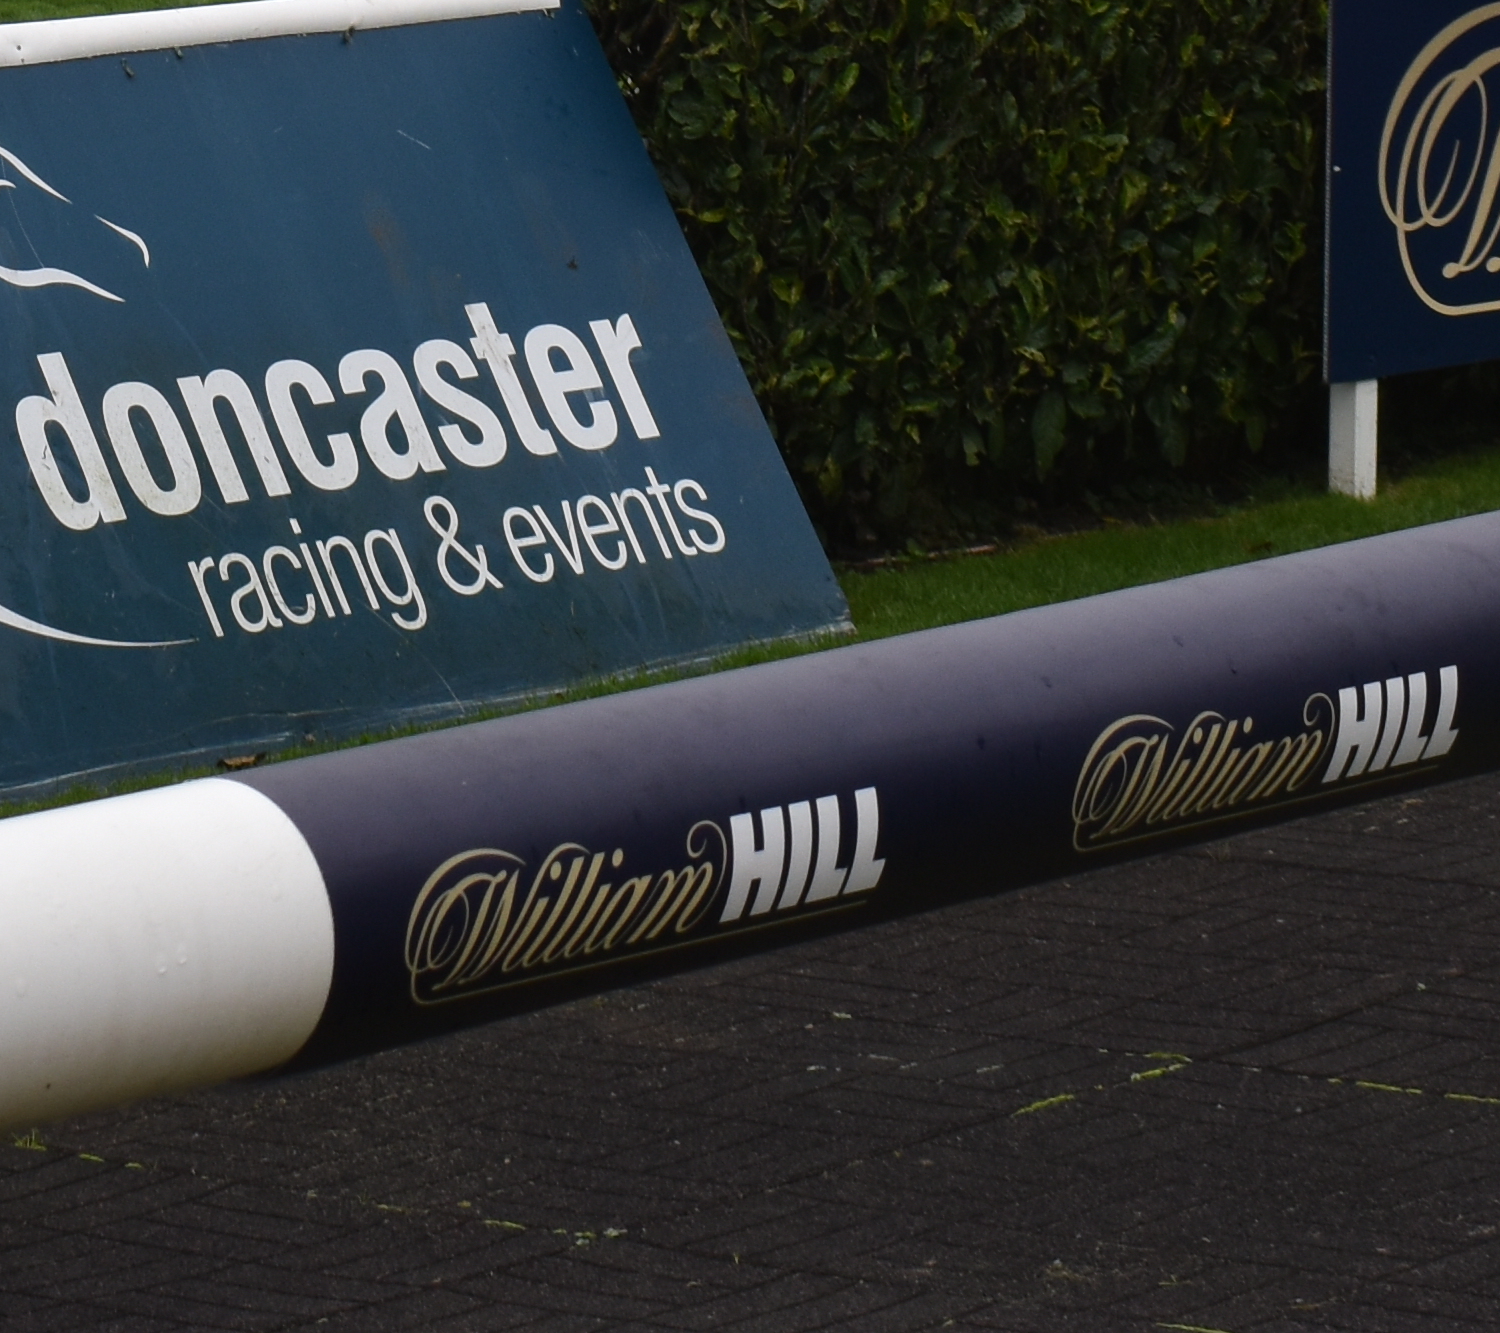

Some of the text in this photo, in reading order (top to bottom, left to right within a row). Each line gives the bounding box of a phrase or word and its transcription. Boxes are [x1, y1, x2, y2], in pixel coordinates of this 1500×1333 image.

[15, 302, 661, 532] doncaster
[187, 465, 727, 641] racing & events
[1071, 664, 1460, 840] William HILL
[404, 786, 887, 992] William HILL
